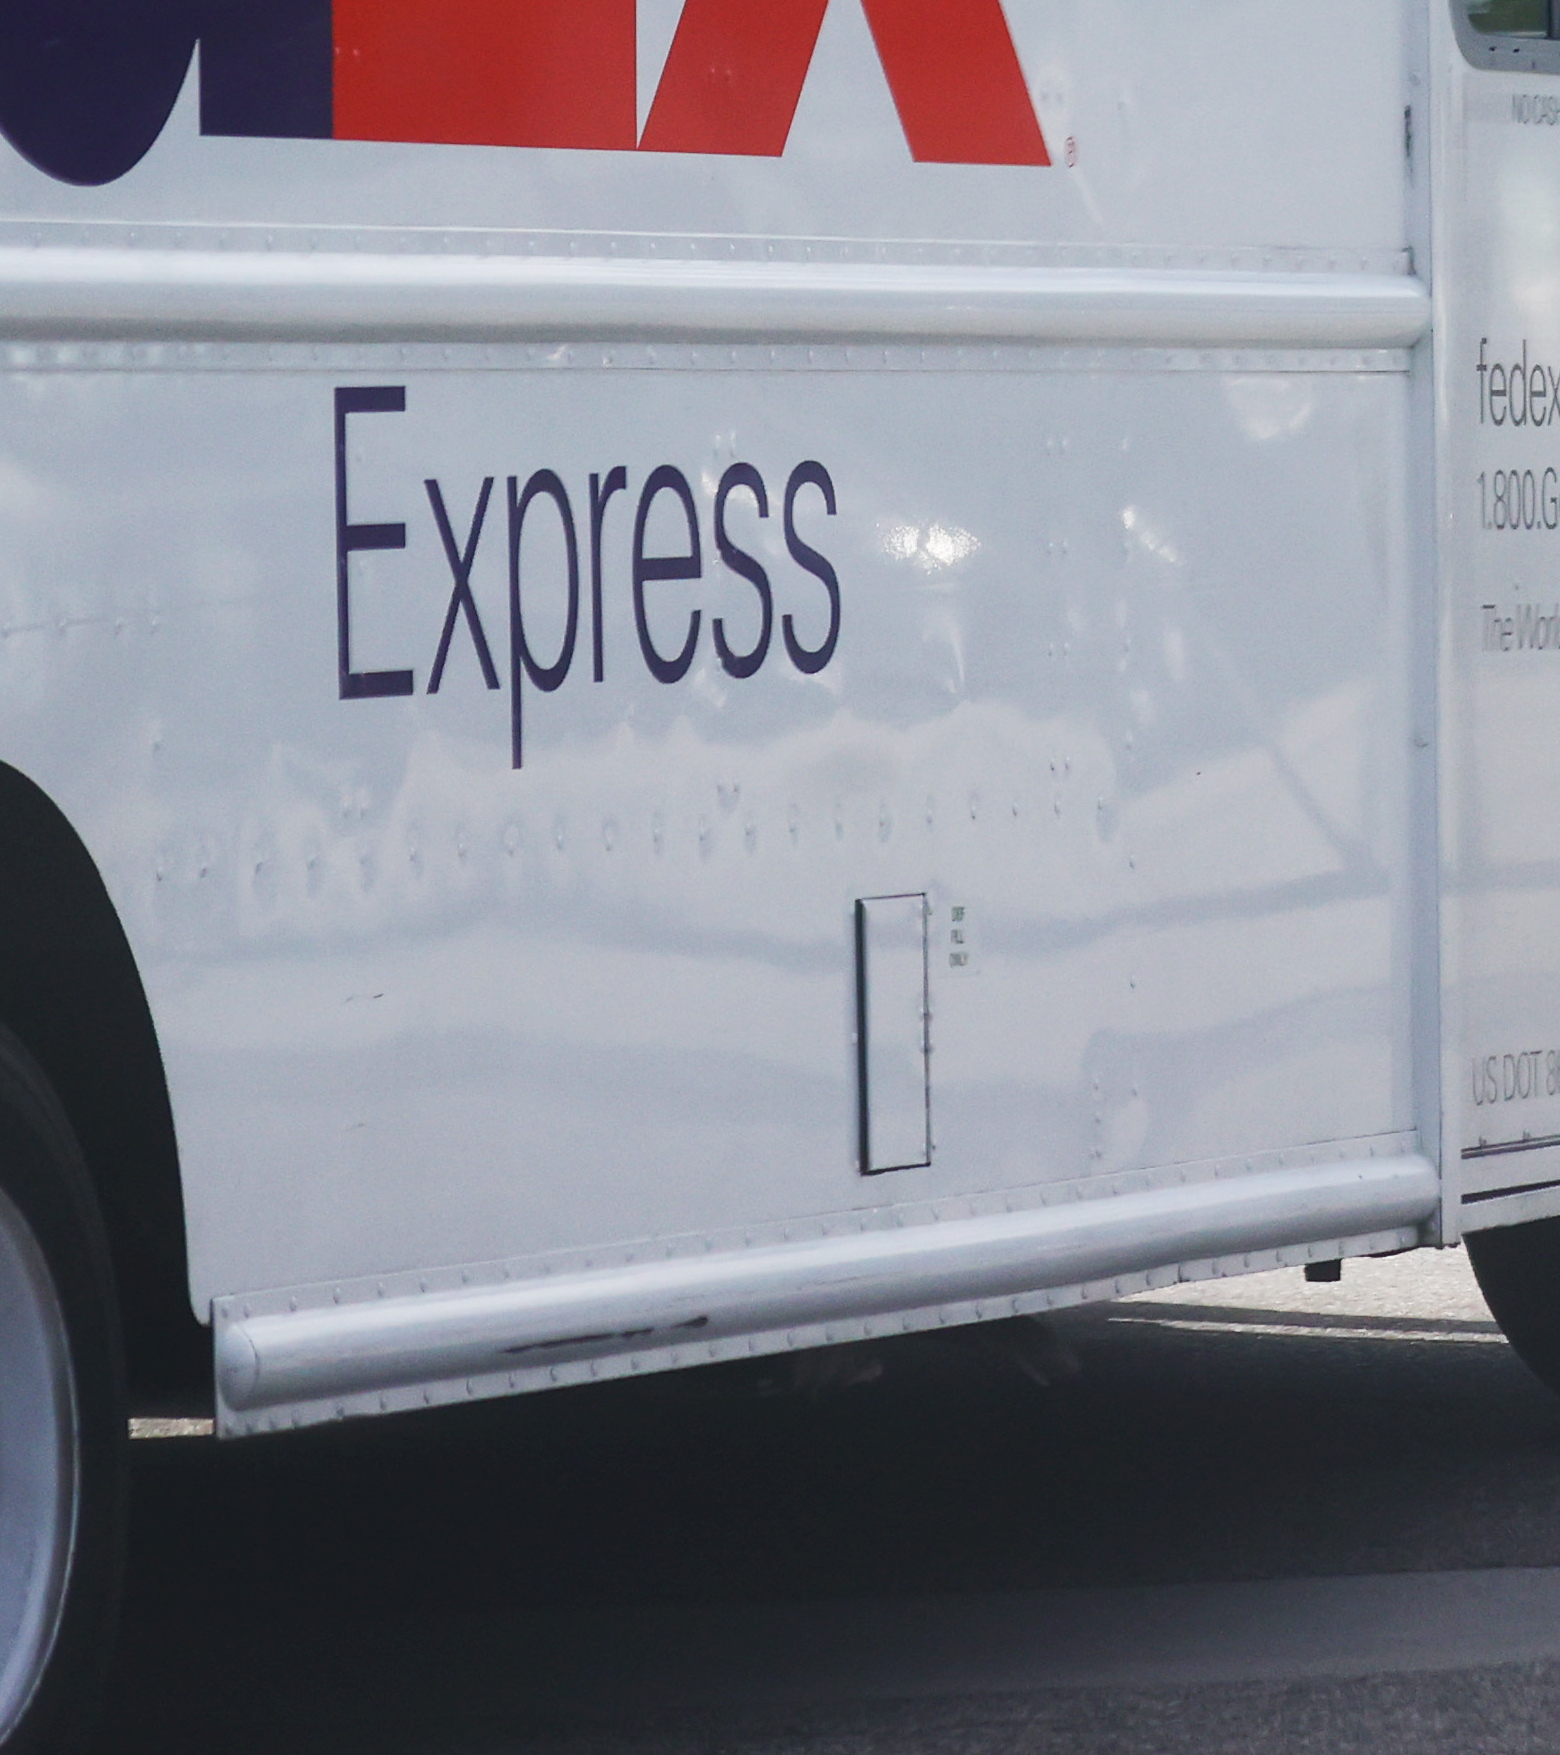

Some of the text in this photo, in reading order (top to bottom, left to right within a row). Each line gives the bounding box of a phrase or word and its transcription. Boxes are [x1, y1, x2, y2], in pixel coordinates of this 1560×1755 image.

[334, 385, 841, 770] Express
[1481, 603, 1514, 652] The
[1471, 1054, 1498, 1106] US
[1502, 1049, 1543, 1102] DOT
